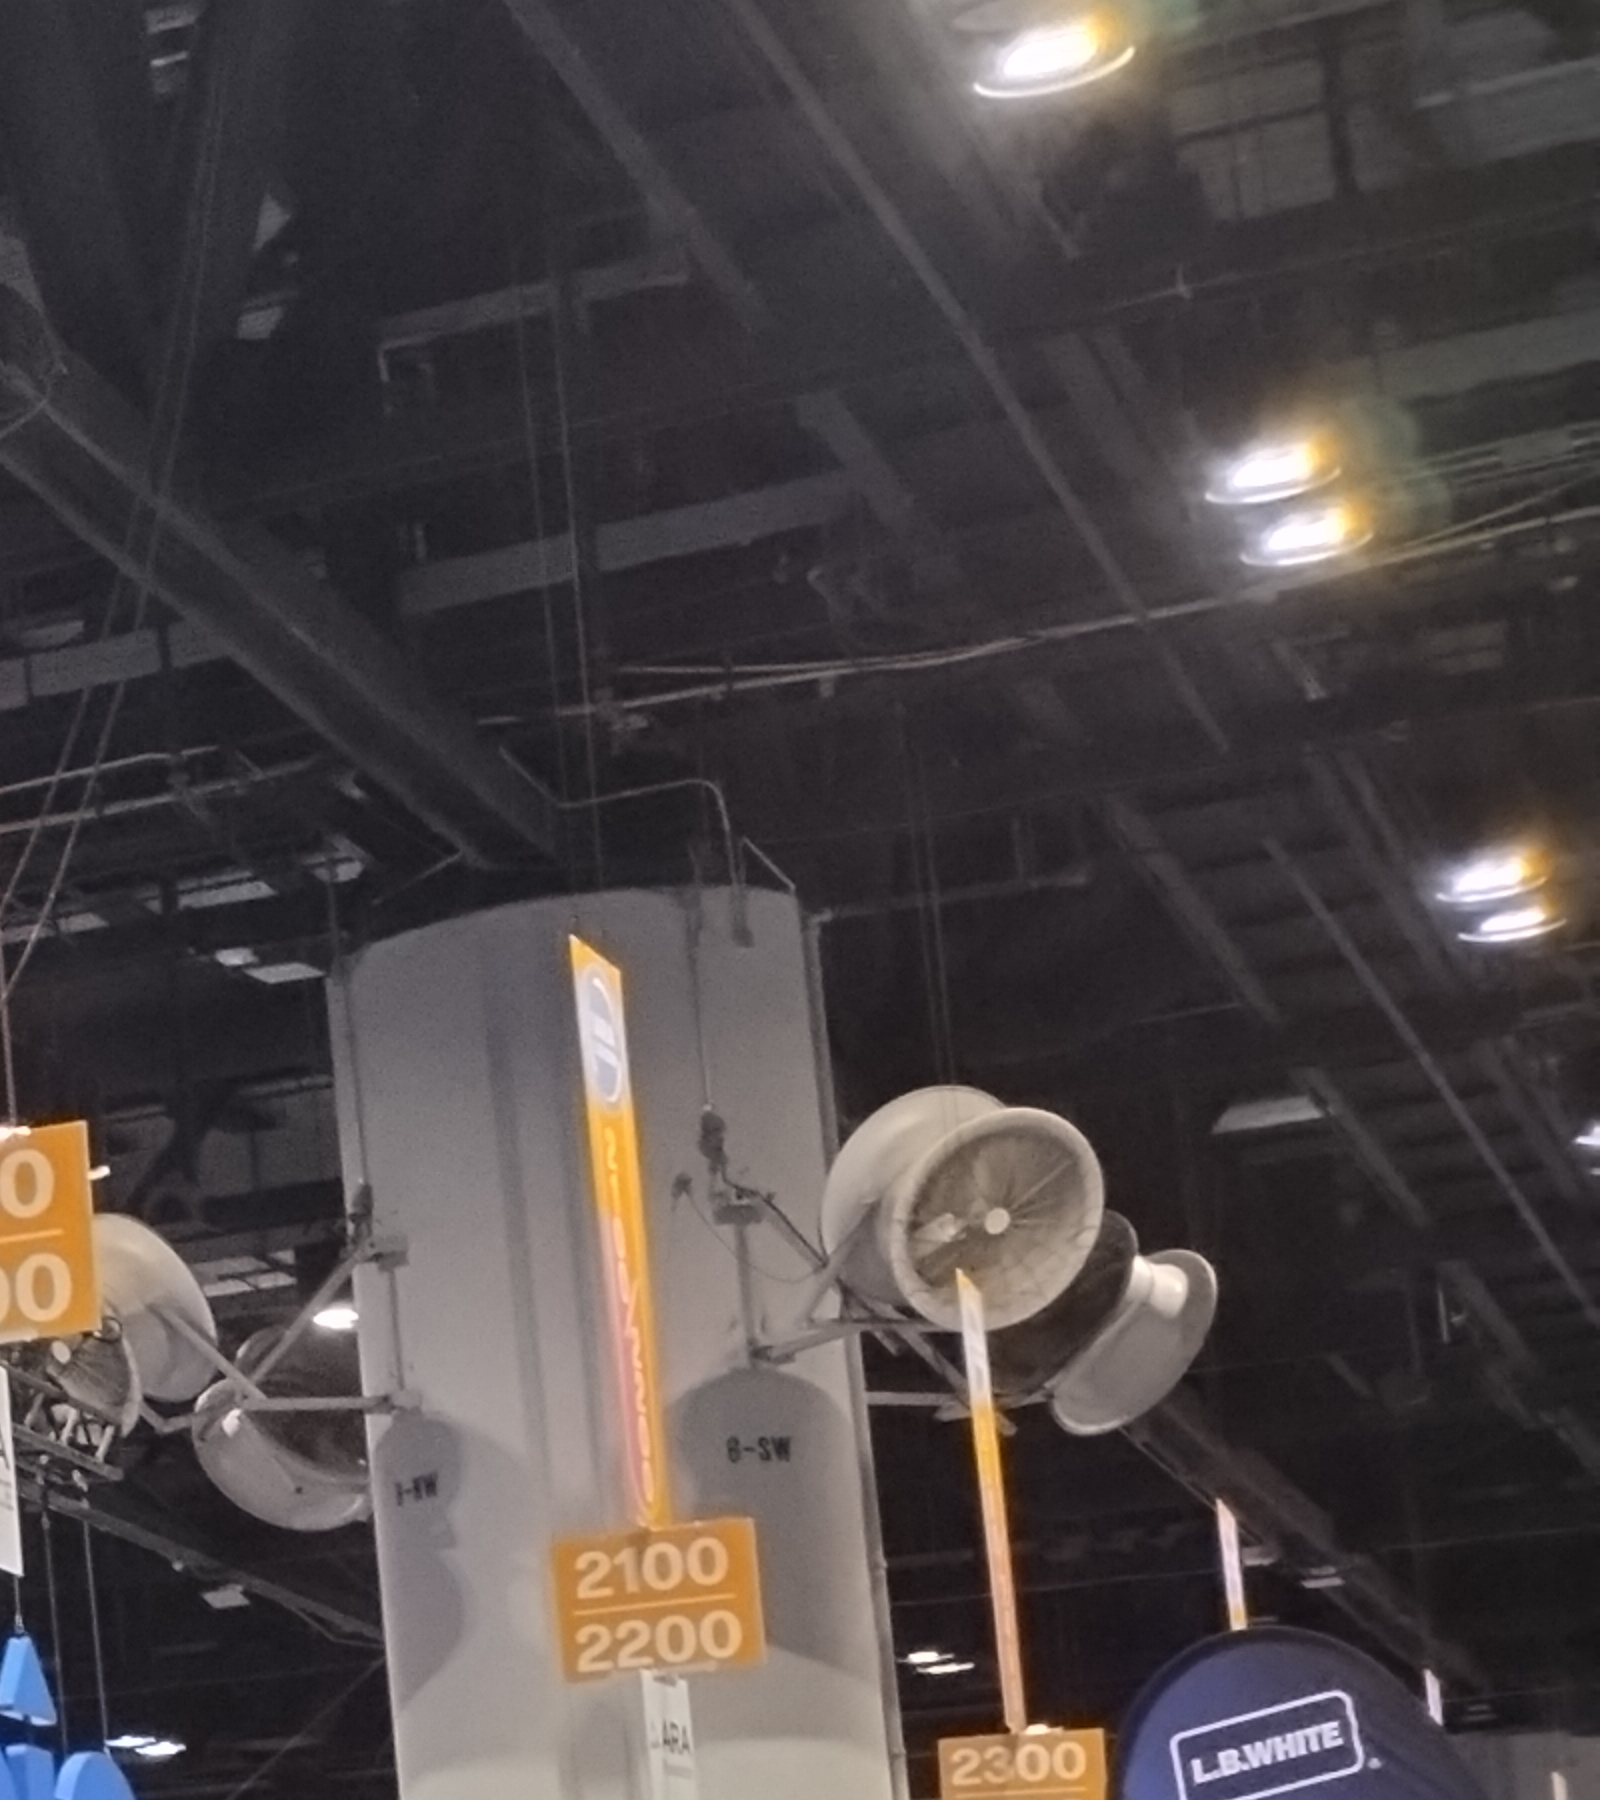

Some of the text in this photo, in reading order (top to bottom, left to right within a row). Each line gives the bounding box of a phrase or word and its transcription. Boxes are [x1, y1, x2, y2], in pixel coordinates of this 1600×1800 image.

[575, 1537, 728, 1597] 2100
[577, 1611, 742, 1673] 2200
[952, 1744, 1086, 1784] 2300
